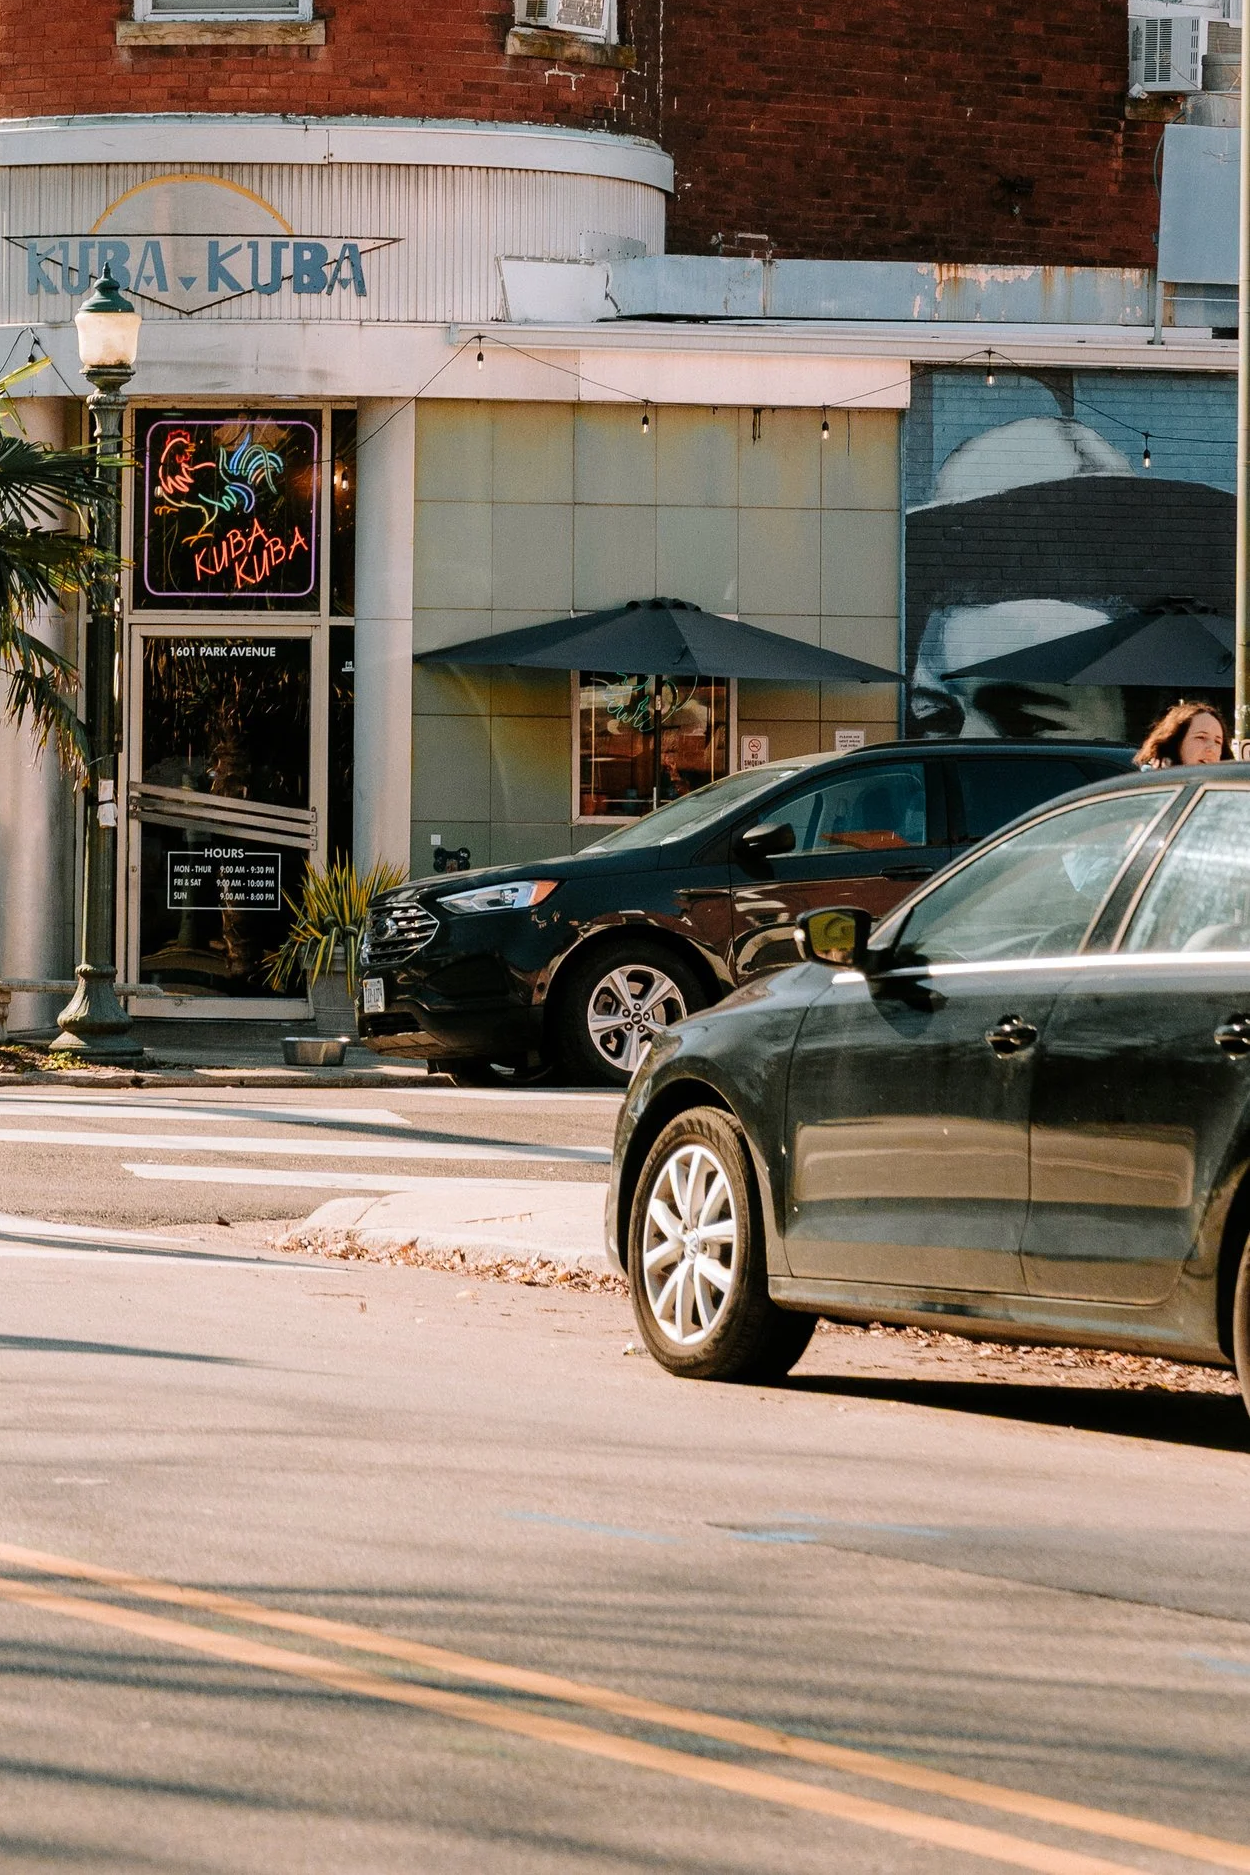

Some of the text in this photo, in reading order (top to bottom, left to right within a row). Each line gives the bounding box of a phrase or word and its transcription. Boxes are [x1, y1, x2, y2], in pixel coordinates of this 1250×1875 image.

[27, 240, 368, 297] KUBA KUBA
[194, 518, 268, 581] KUBA
[234, 527, 308, 589] KUBA
[170, 646, 276, 657] 1601 PARK AVENUE
[204, 848, 245, 858] HOURS
[174, 865, 190, 873] MON
[195, 865, 211, 873] THUR
[251, 866, 264, 874] 9:30
[265, 866, 275, 874] PM
[231, 879, 241, 887] AM
[174, 892, 187, 900] SUN
